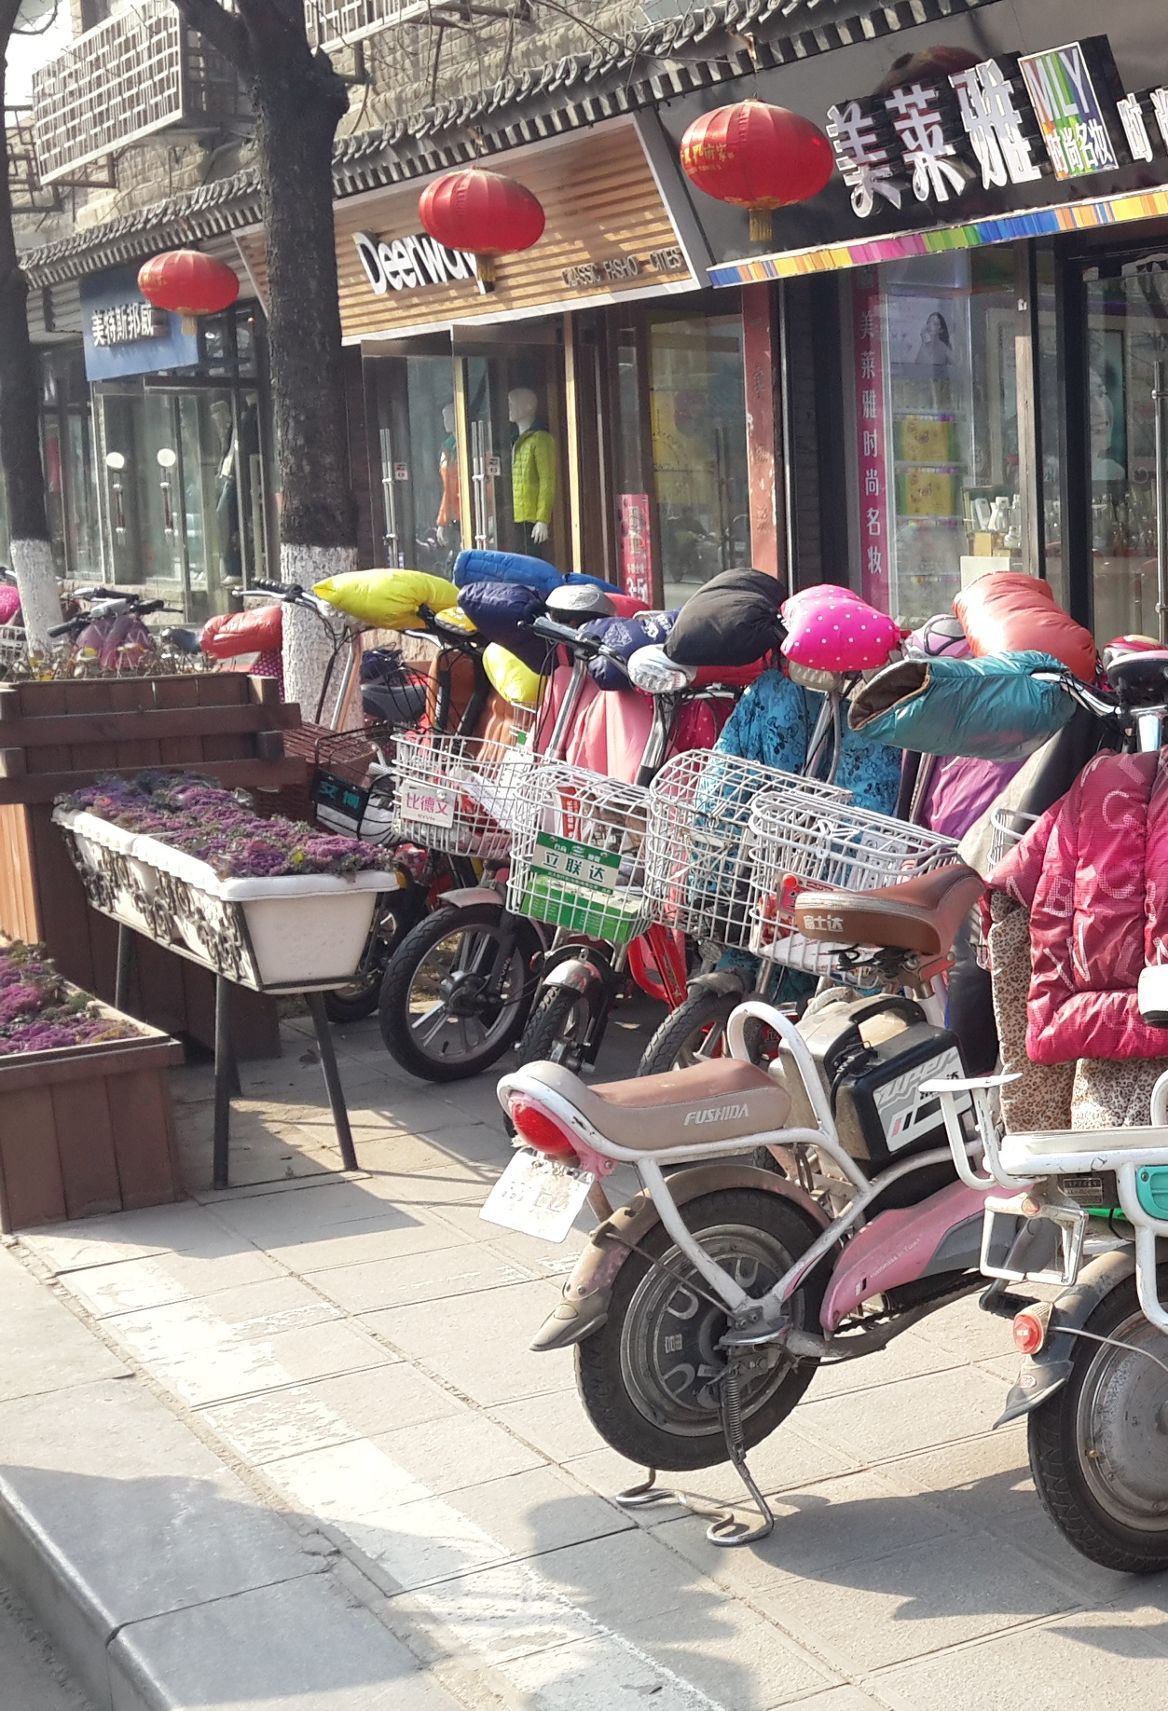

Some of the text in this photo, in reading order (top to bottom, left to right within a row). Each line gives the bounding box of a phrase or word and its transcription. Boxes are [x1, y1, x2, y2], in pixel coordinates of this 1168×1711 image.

[1023, 48, 1090, 122] MLY
[826, 58, 1041, 218] 美莱雅
[1046, 118, 1114, 173] 时尚名妆
[860, 311, 882, 575] 美莱雅时尚名妆
[543, 852, 605, 884] 立联达
[683, 1103, 749, 1126] FUSHIDA
